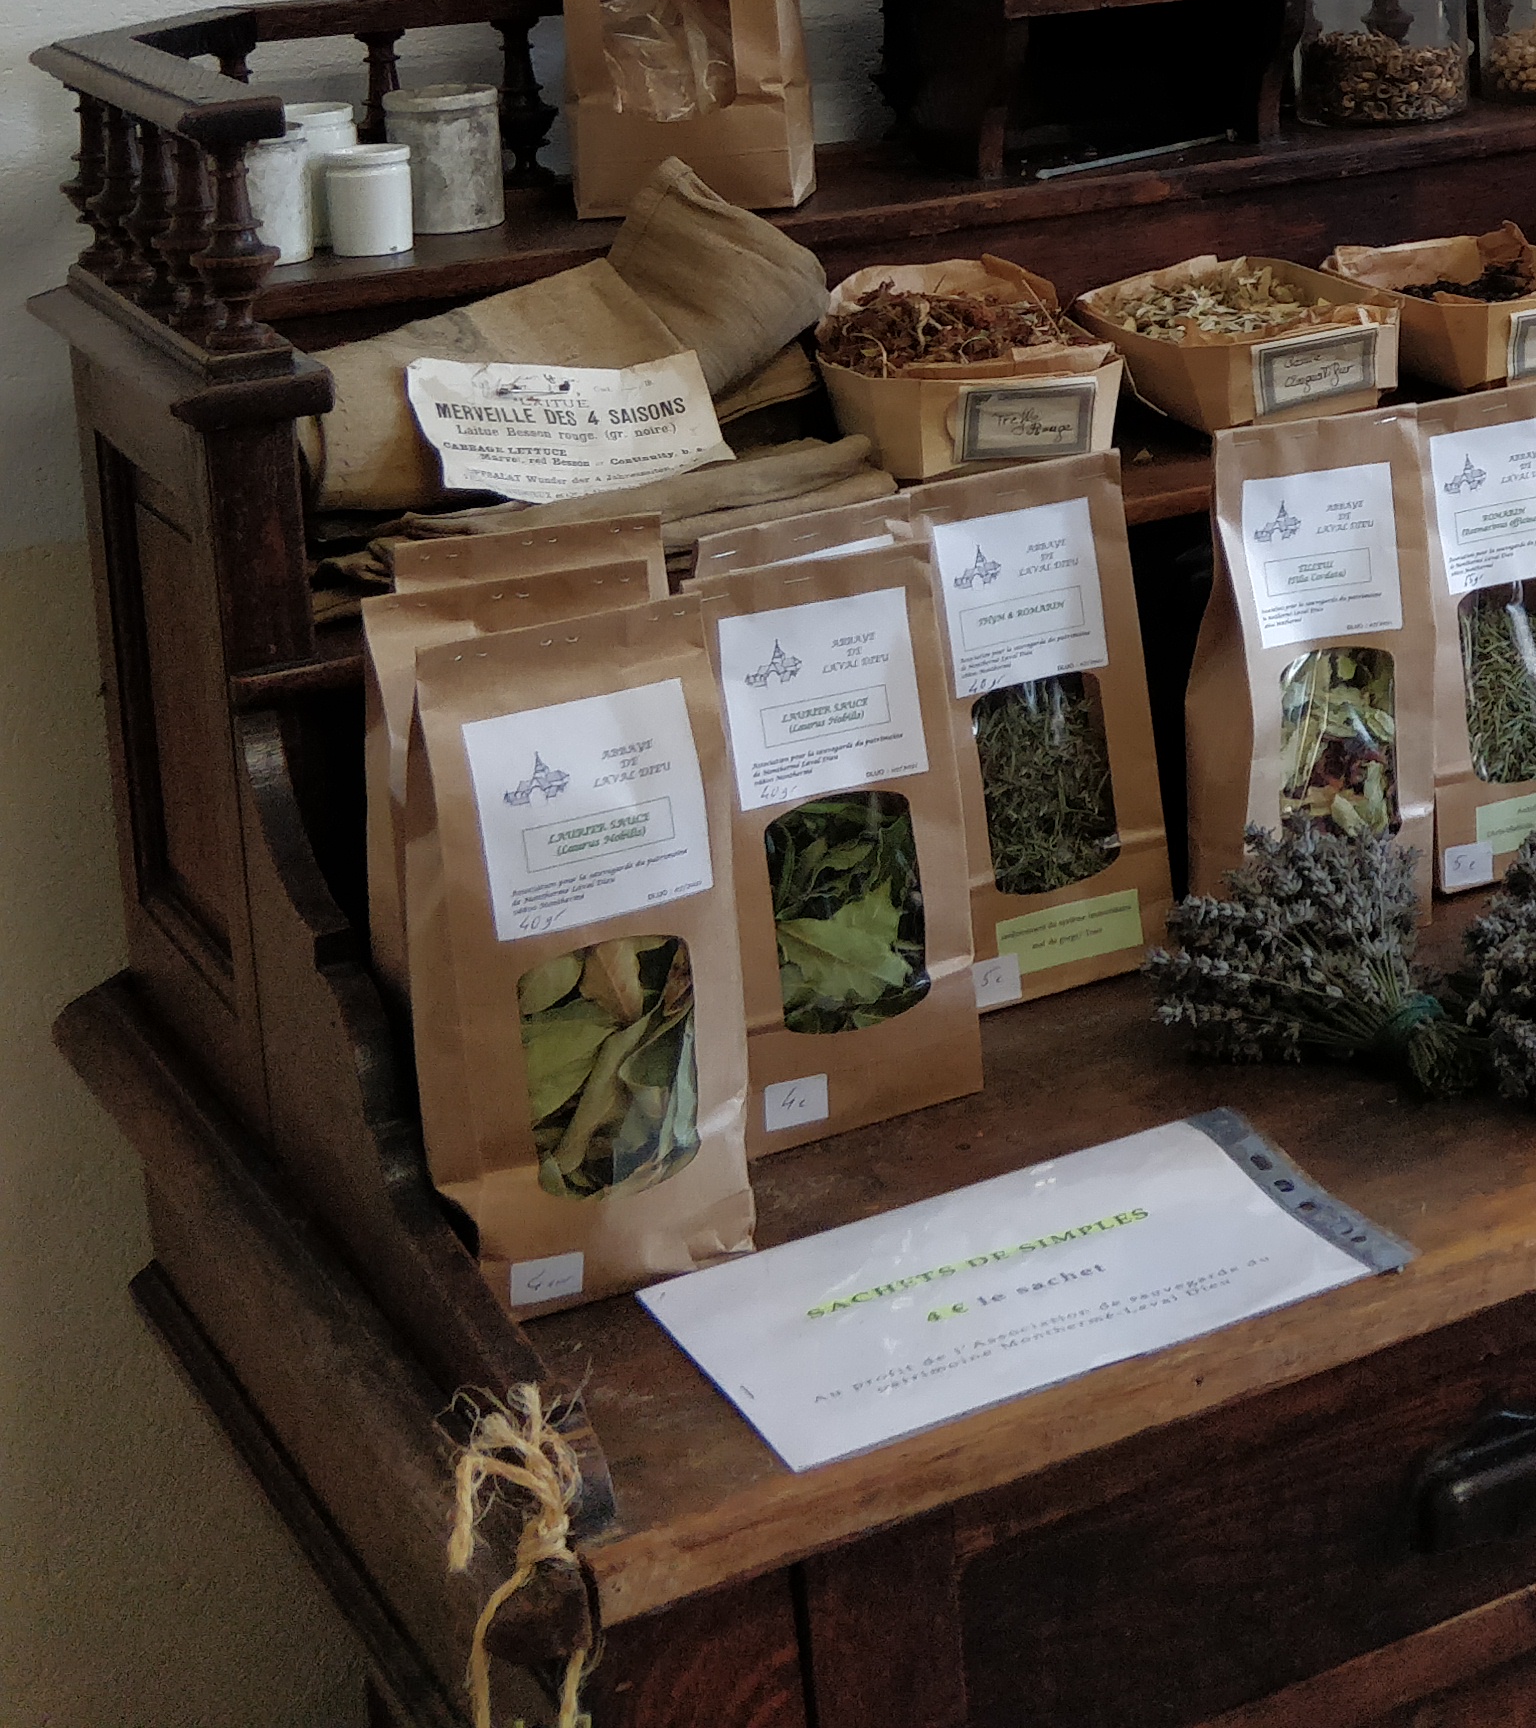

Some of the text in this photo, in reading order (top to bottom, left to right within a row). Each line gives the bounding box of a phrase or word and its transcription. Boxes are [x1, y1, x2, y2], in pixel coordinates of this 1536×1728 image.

[435, 397, 686, 426] MERVEILLE DES 4 SAISONS
[457, 425, 499, 437] Laitue
[507, 427, 552, 439] Besson
[443, 442, 567, 456] CABBAGE LETTUCE
[553, 456, 590, 467] Besson
[1326, 500, 1363, 512] ABBAYE
[1026, 539, 1066, 553] ABBAYE
[1019, 563, 1051, 577] LAVAL
[1017, 600, 1065, 618] ROMARIN
[831, 632, 875, 648] ABBAYE
[847, 647, 862, 657] DE
[822, 653, 889, 673] LAVAL DIEU
[781, 697, 868, 723] LAURIER SAUCE
[601, 738, 653, 760] ABBAYE
[620, 757, 638, 767] DE
[593, 762, 671, 788] LAVAL DIEU
[549, 812, 650, 844] LAURIER SAUCE
[807, 1207, 1149, 1319] SACHETS DE SIMPLES
[927, 1263, 1106, 1322] 4 € le sachet
[815, 1390, 841, 1403] Au
[852, 1364, 912, 1391] profit
[924, 1354, 946, 1366] de
[1100, 1300, 1120, 1310] de
[1130, 1266, 1238, 1302] sauvegarde
[1247, 1257, 1269, 1267] du
